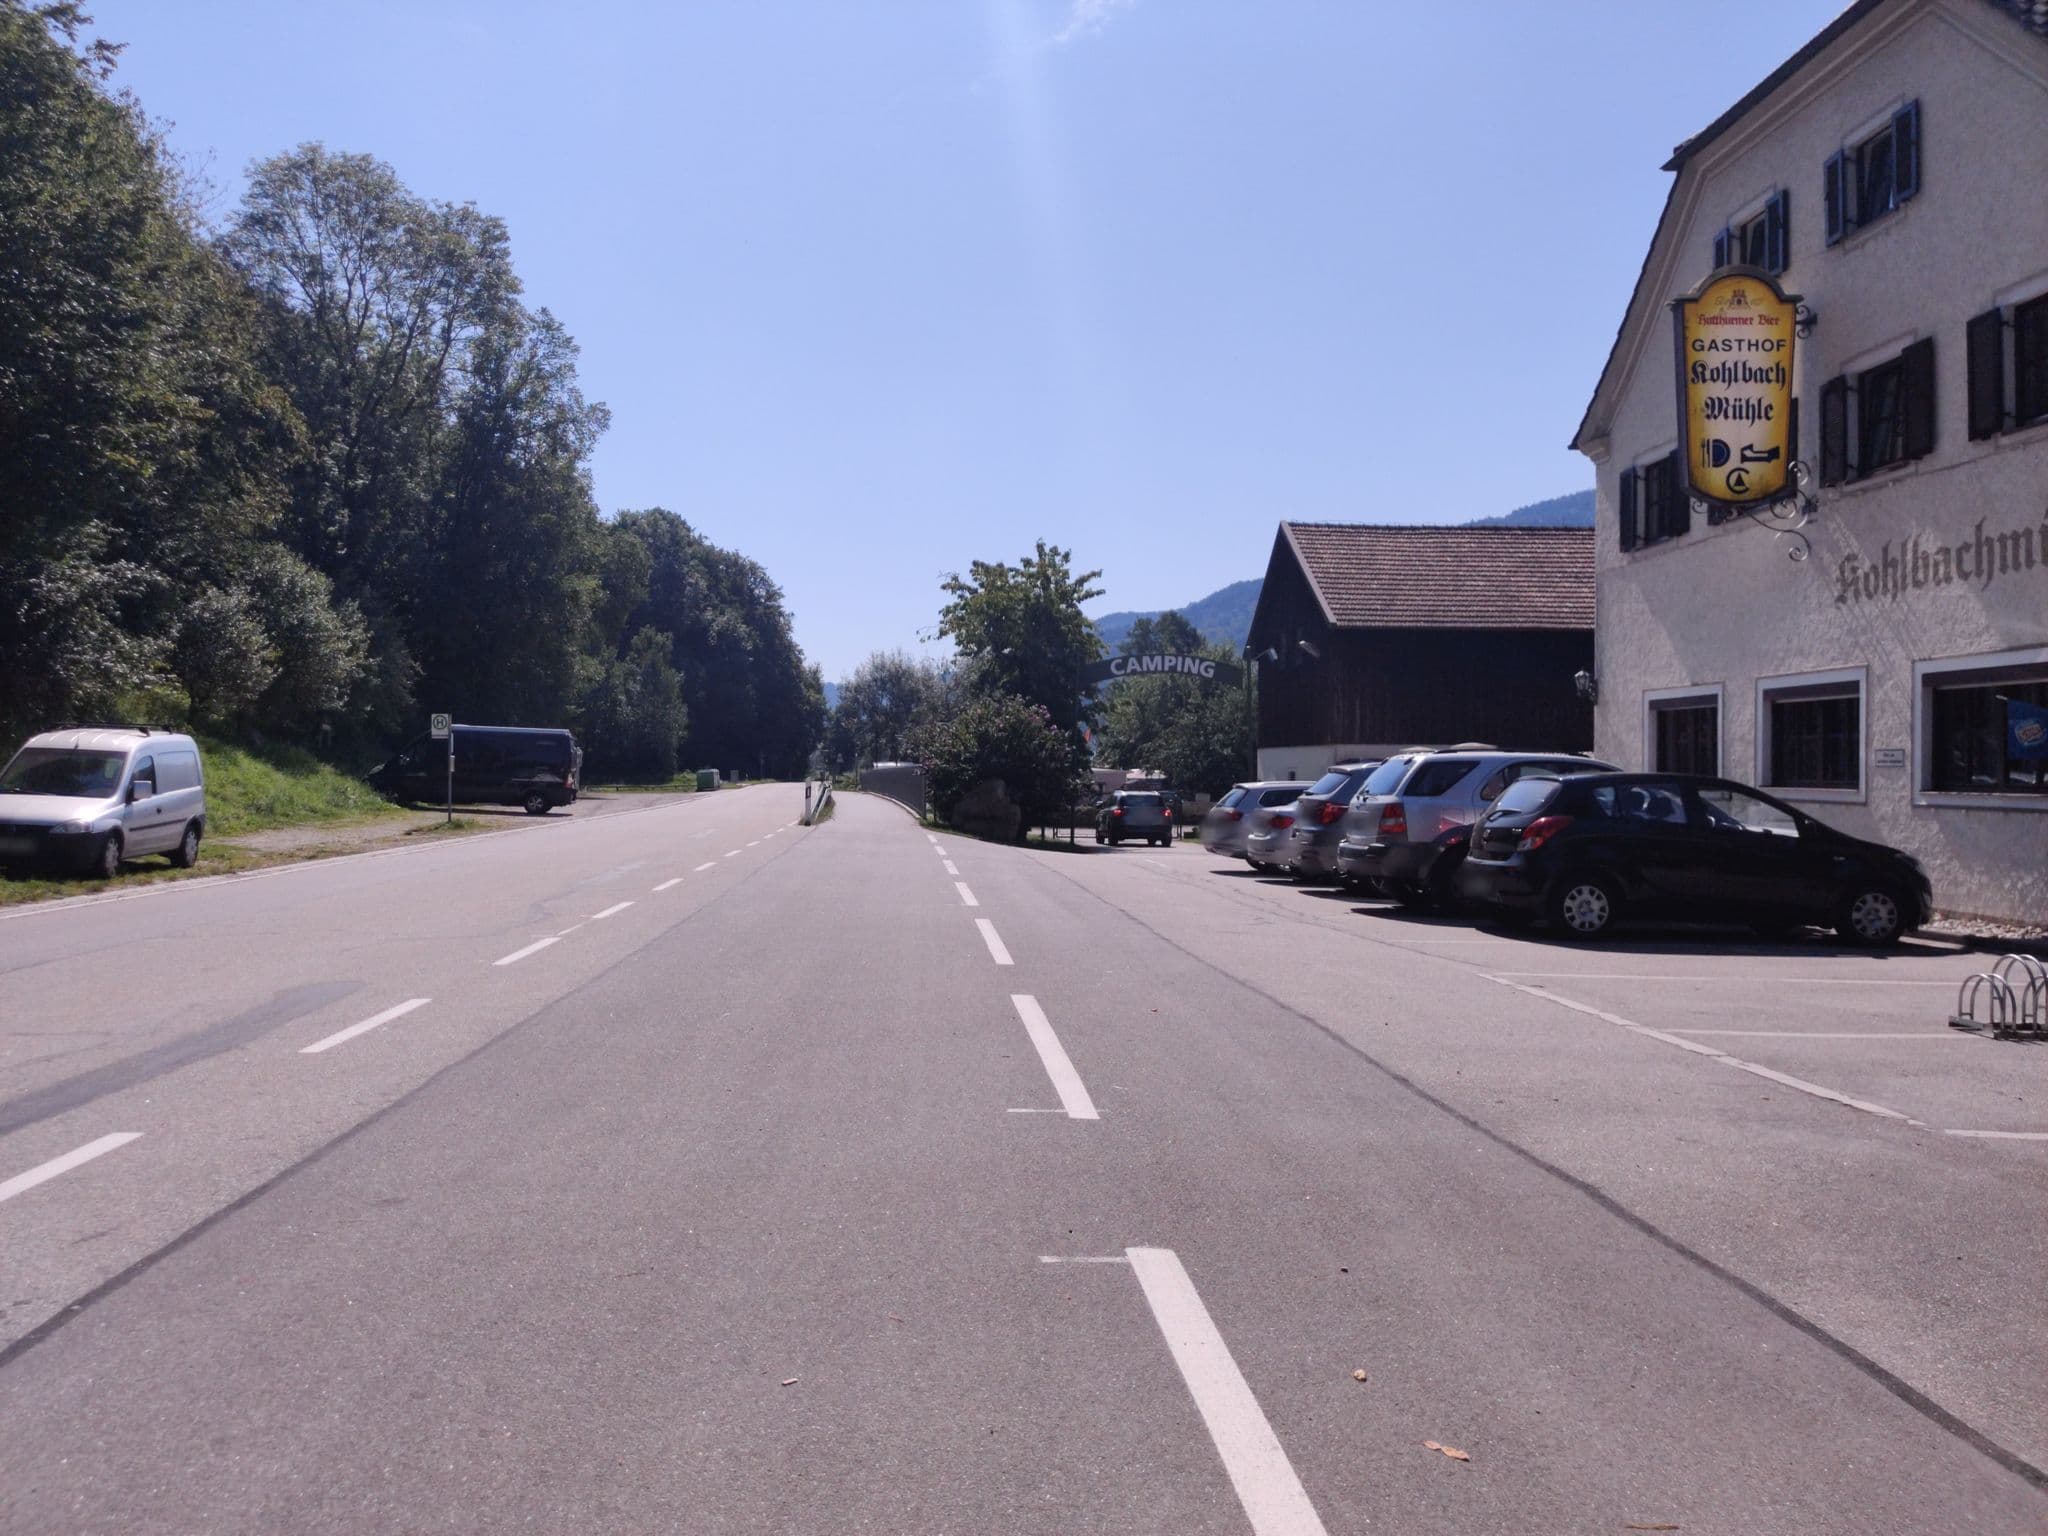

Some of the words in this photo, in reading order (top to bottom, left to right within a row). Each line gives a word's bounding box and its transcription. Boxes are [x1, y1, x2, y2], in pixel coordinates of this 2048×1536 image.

[1758, 314, 1780, 326] Bier
[1692, 339, 1787, 352] GASTHOF
[1691, 360, 1786, 390] Kohlbach
[1704, 397, 1774, 427] Mühle
[1110, 655, 1216, 678] CAMPING
